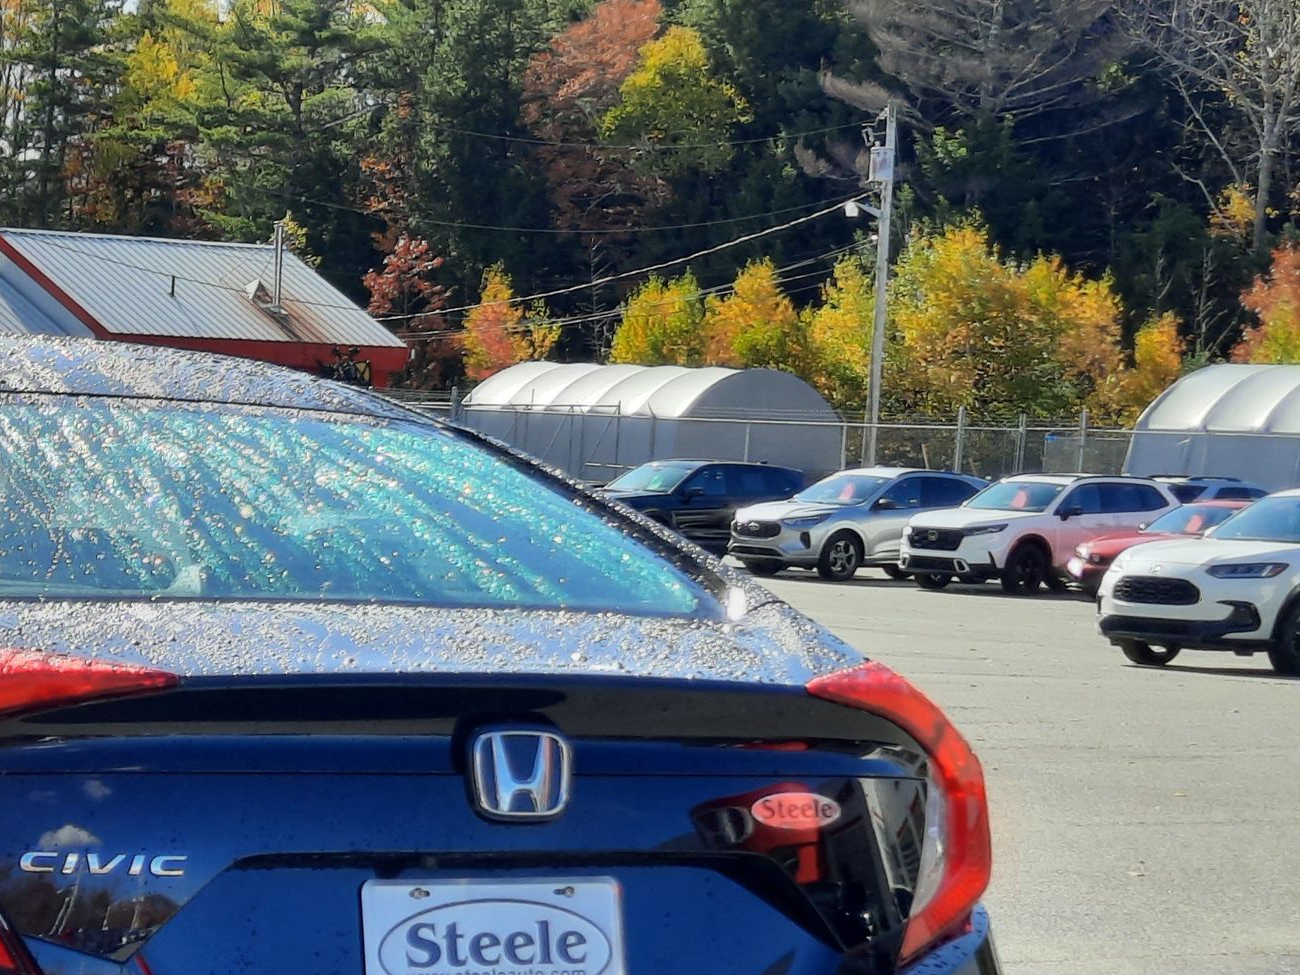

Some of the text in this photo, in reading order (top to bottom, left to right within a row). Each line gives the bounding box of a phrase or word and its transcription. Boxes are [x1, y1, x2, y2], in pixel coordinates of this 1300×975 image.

[762, 798, 834, 819] Steele
[19, 851, 189, 878] CIVIC
[405, 919, 588, 969] Steele
